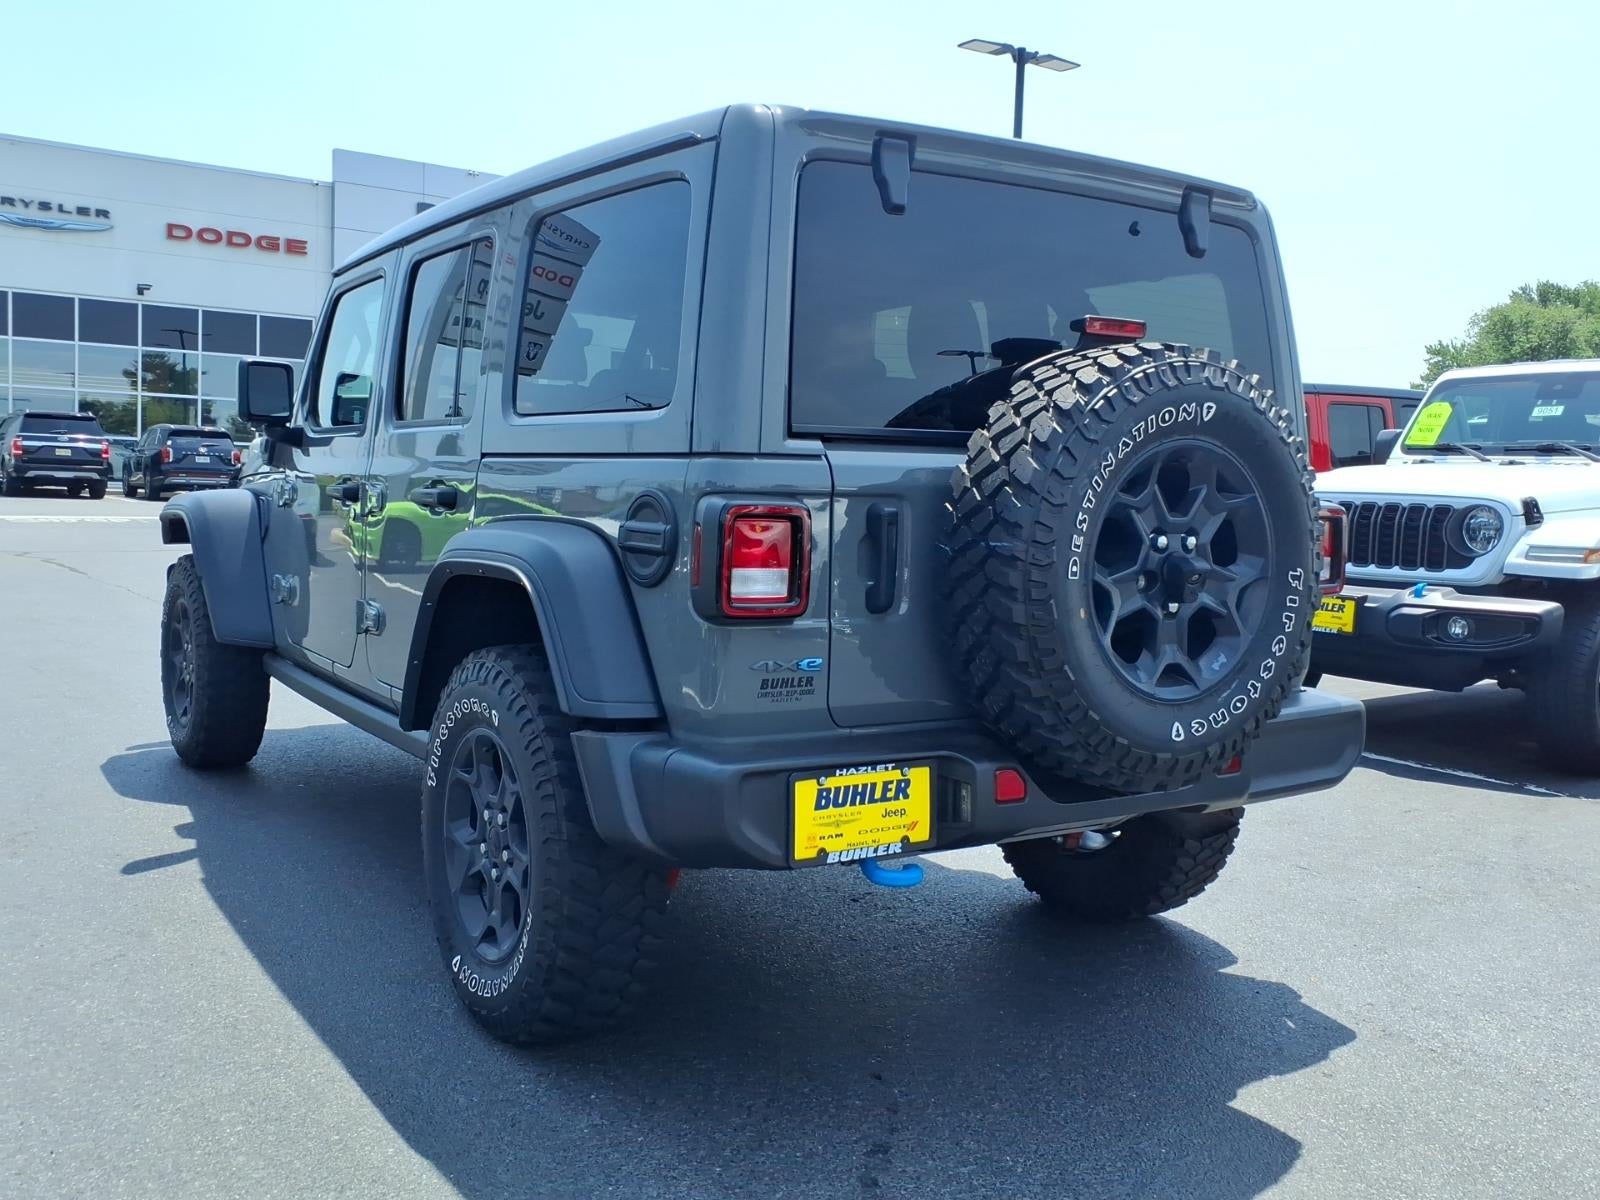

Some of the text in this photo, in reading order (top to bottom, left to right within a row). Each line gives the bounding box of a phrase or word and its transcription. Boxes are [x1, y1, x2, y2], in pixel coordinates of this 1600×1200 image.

[166, 222, 308, 256] DODGE
[1537, 407, 1558, 415] 9051
[1068, 402, 1196, 580] DESTINATION
[1190, 567, 1304, 736] Firestone
[760, 676, 814, 690] BUHLER
[427, 698, 490, 787] Firestone
[835, 763, 896, 776] HAZLET
[814, 778, 912, 811] BUHLER
[813, 811, 862, 821] CHRYSLER
[881, 807, 907, 819] Jeep
[858, 823, 912, 835] DODGE
[819, 832, 844, 841] RAM
[826, 842, 903, 864] BUHLER
